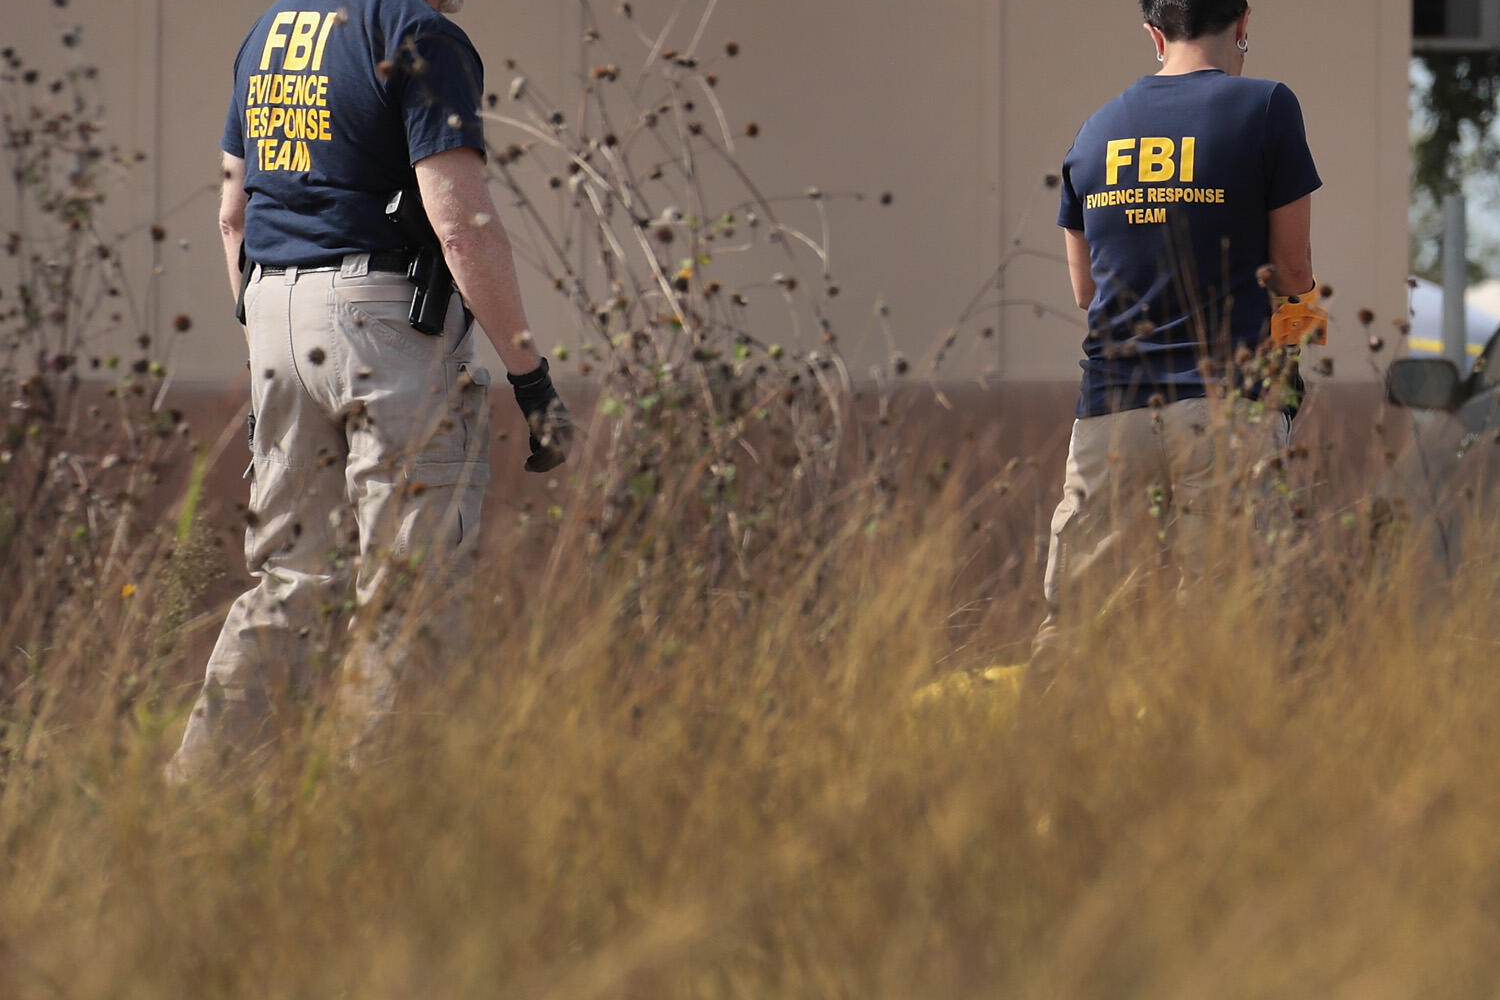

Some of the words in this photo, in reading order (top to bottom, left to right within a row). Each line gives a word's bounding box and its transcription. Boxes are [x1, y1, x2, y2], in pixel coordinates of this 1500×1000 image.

[259, 11, 337, 71] FBI
[247, 74, 329, 106] EVIDENCE
[257, 139, 311, 172] TEAM
[1105, 136, 1196, 185] FBI
[1086, 189, 1144, 209] EVIDENCE
[1147, 187, 1225, 203] RESPONSE
[1125, 208, 1167, 225] TEAM
